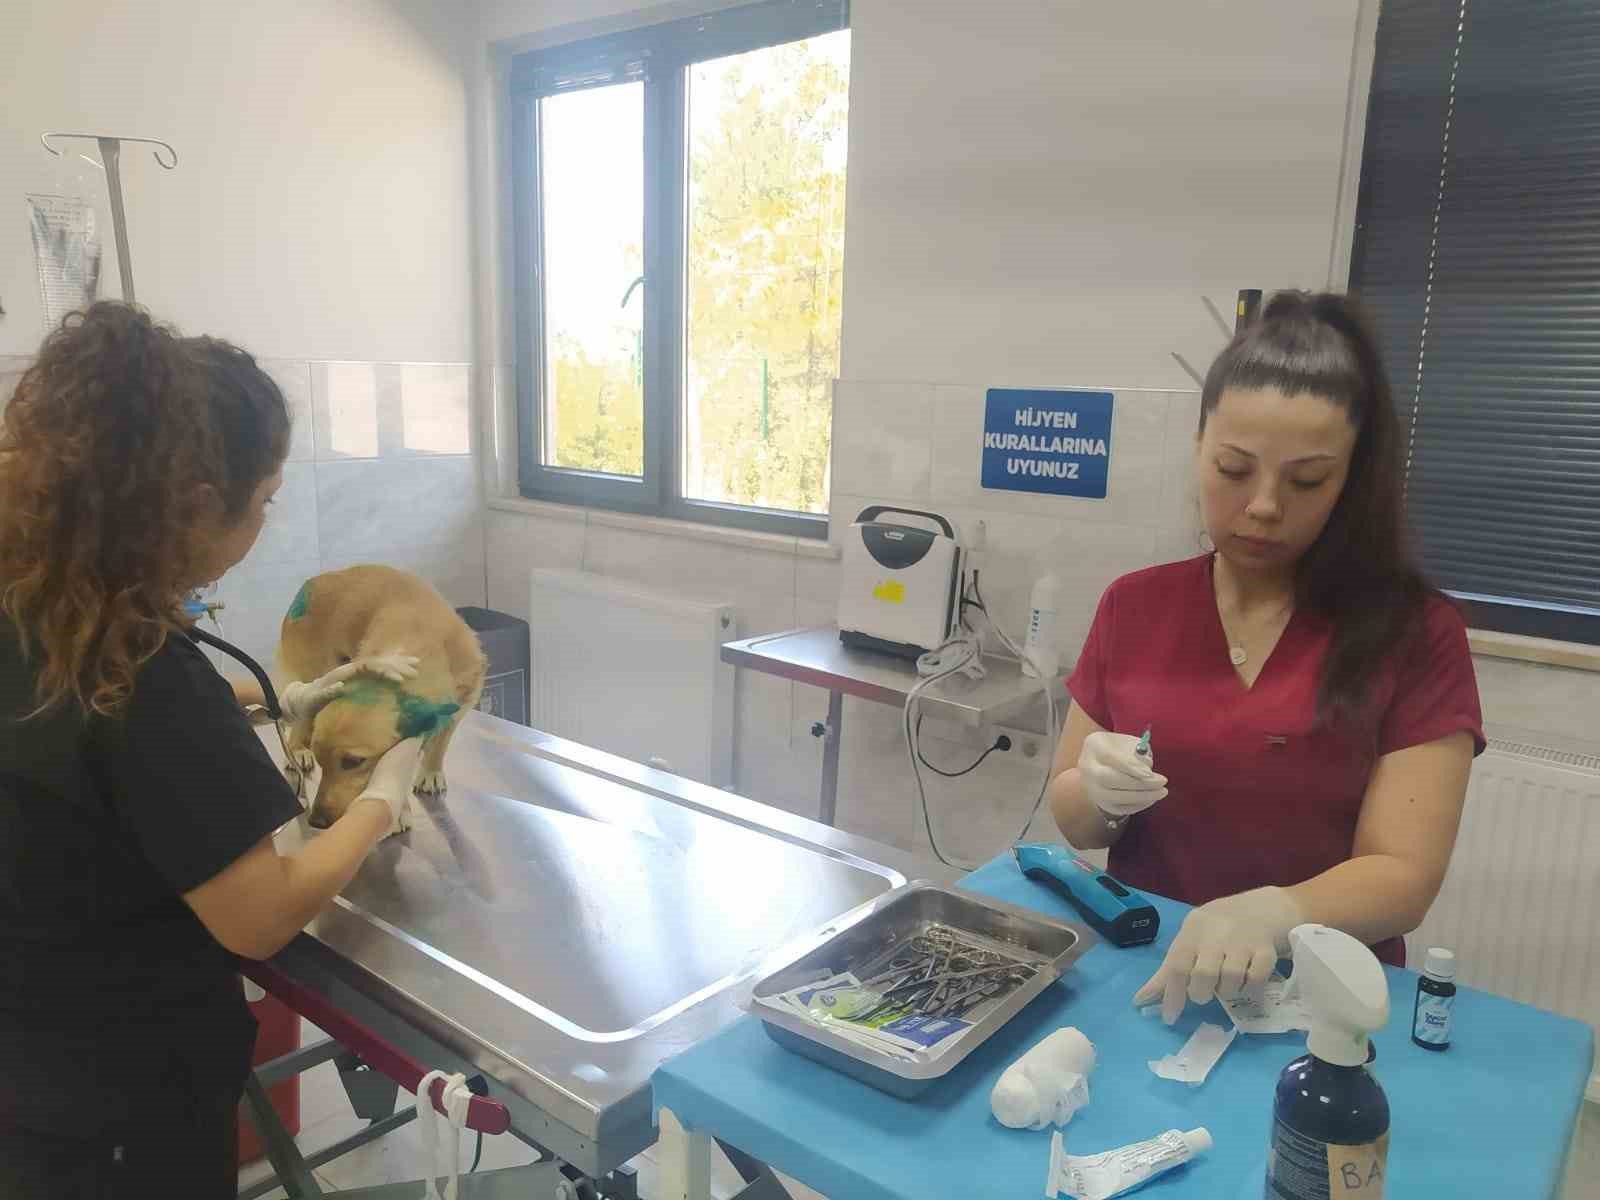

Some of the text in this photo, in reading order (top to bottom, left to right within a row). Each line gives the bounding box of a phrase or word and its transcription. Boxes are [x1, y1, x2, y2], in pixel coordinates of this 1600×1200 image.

[1015, 407, 1077, 428] HİJYEN
[984, 432, 1106, 456] KURALLARINA
[1007, 458, 1080, 479] UYUNUZ
